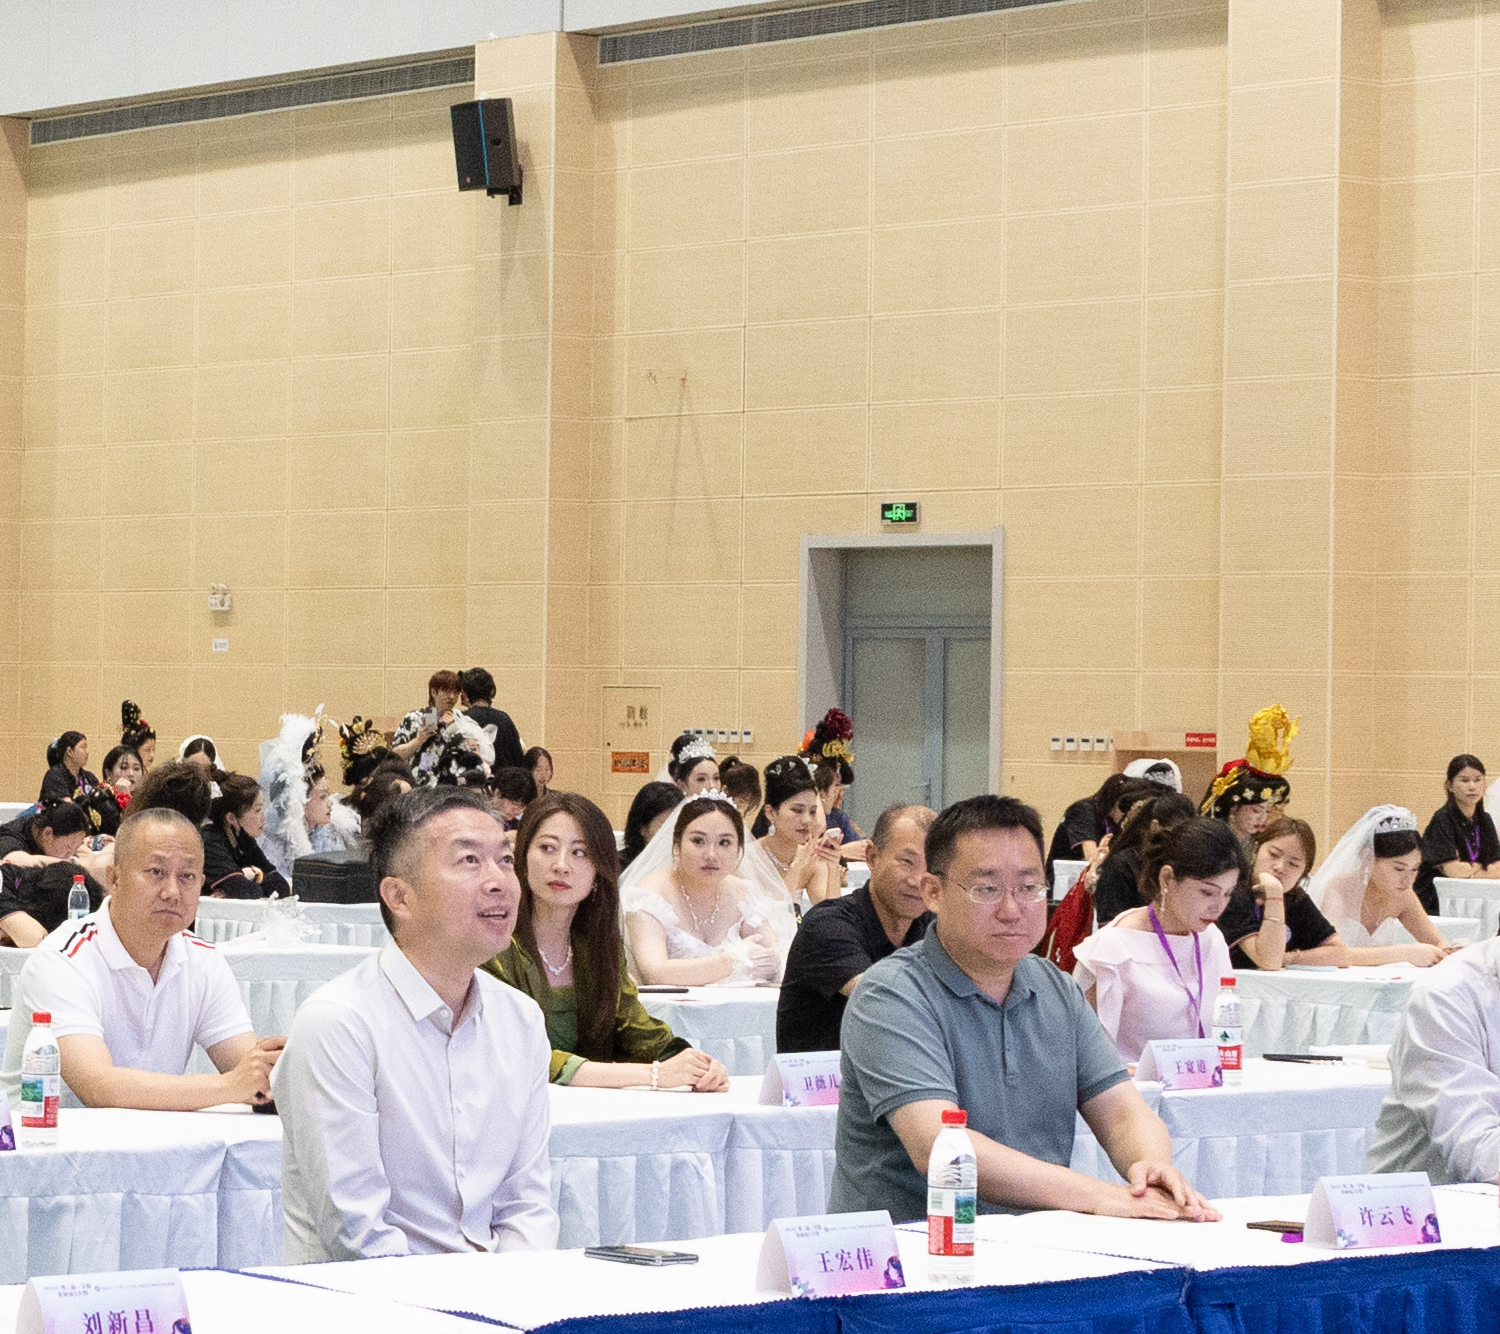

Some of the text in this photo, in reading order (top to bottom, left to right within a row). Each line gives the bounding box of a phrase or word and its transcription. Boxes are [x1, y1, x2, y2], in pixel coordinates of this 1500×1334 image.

[1358, 1205, 1414, 1228] 许云飞
[816, 1247, 874, 1273] 王宏伟
